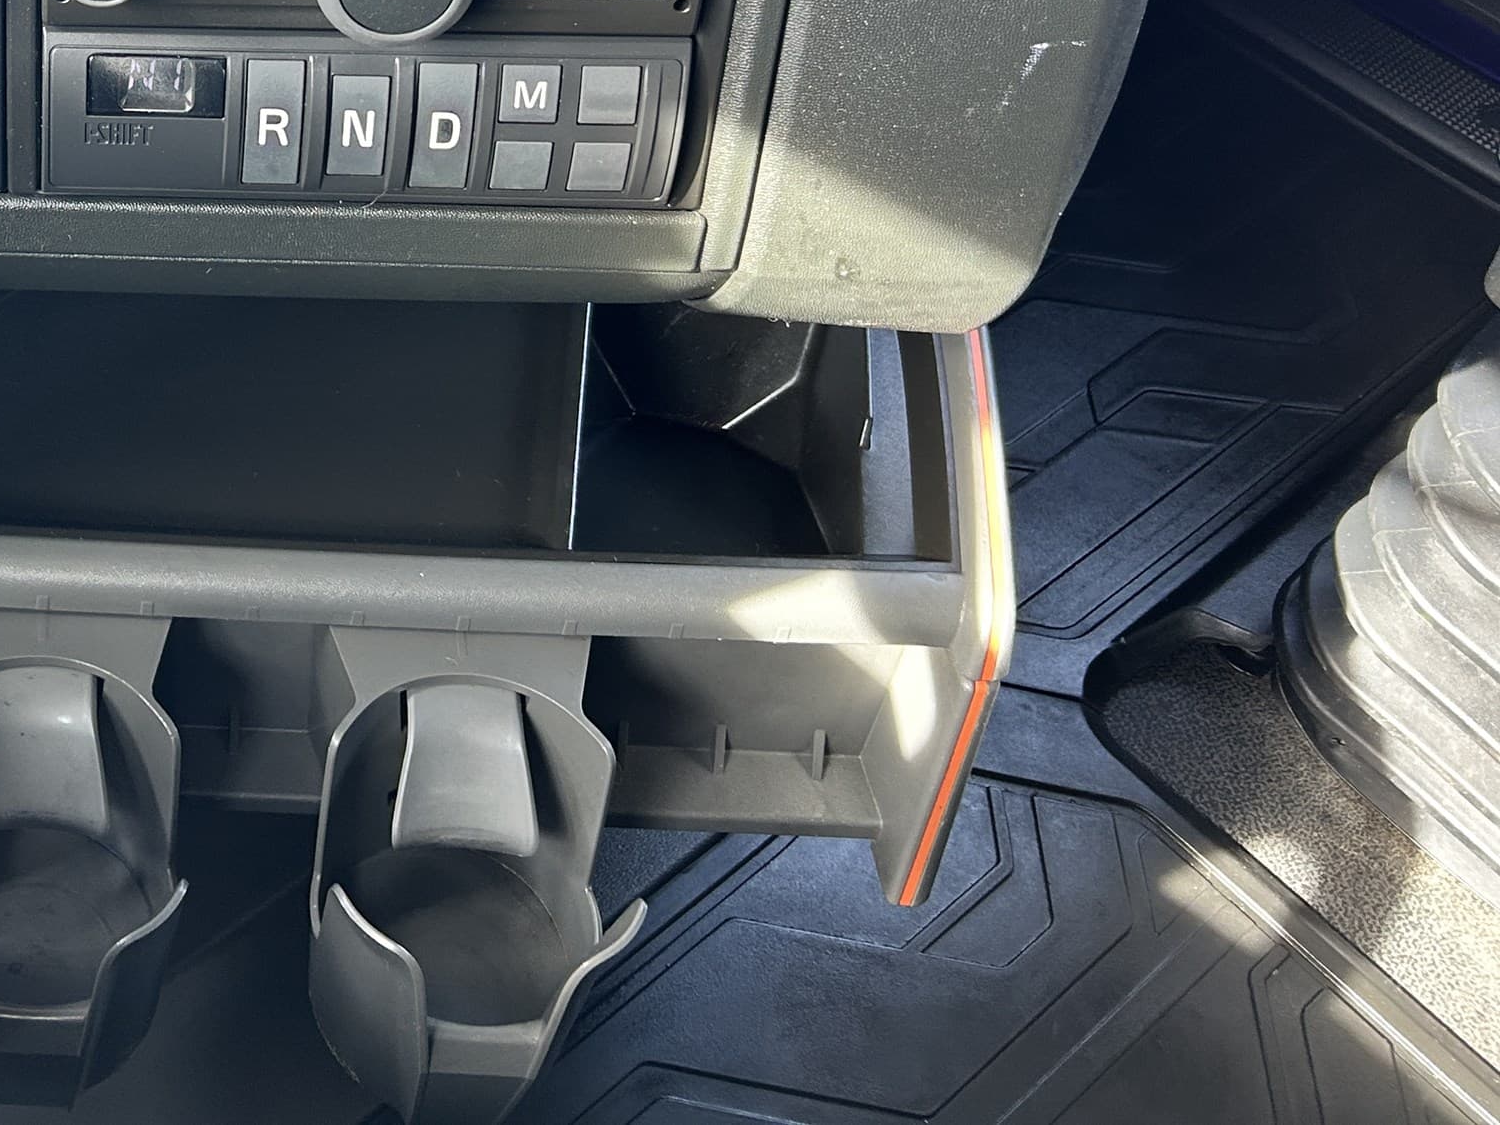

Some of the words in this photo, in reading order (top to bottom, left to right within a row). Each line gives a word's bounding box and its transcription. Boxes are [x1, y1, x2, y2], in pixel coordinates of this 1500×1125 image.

[513, 80, 548, 110] M
[84, 122, 155, 146] I-SHIFT
[257, 108, 290, 147] R
[341, 109, 376, 148] N
[428, 111, 462, 150] D
